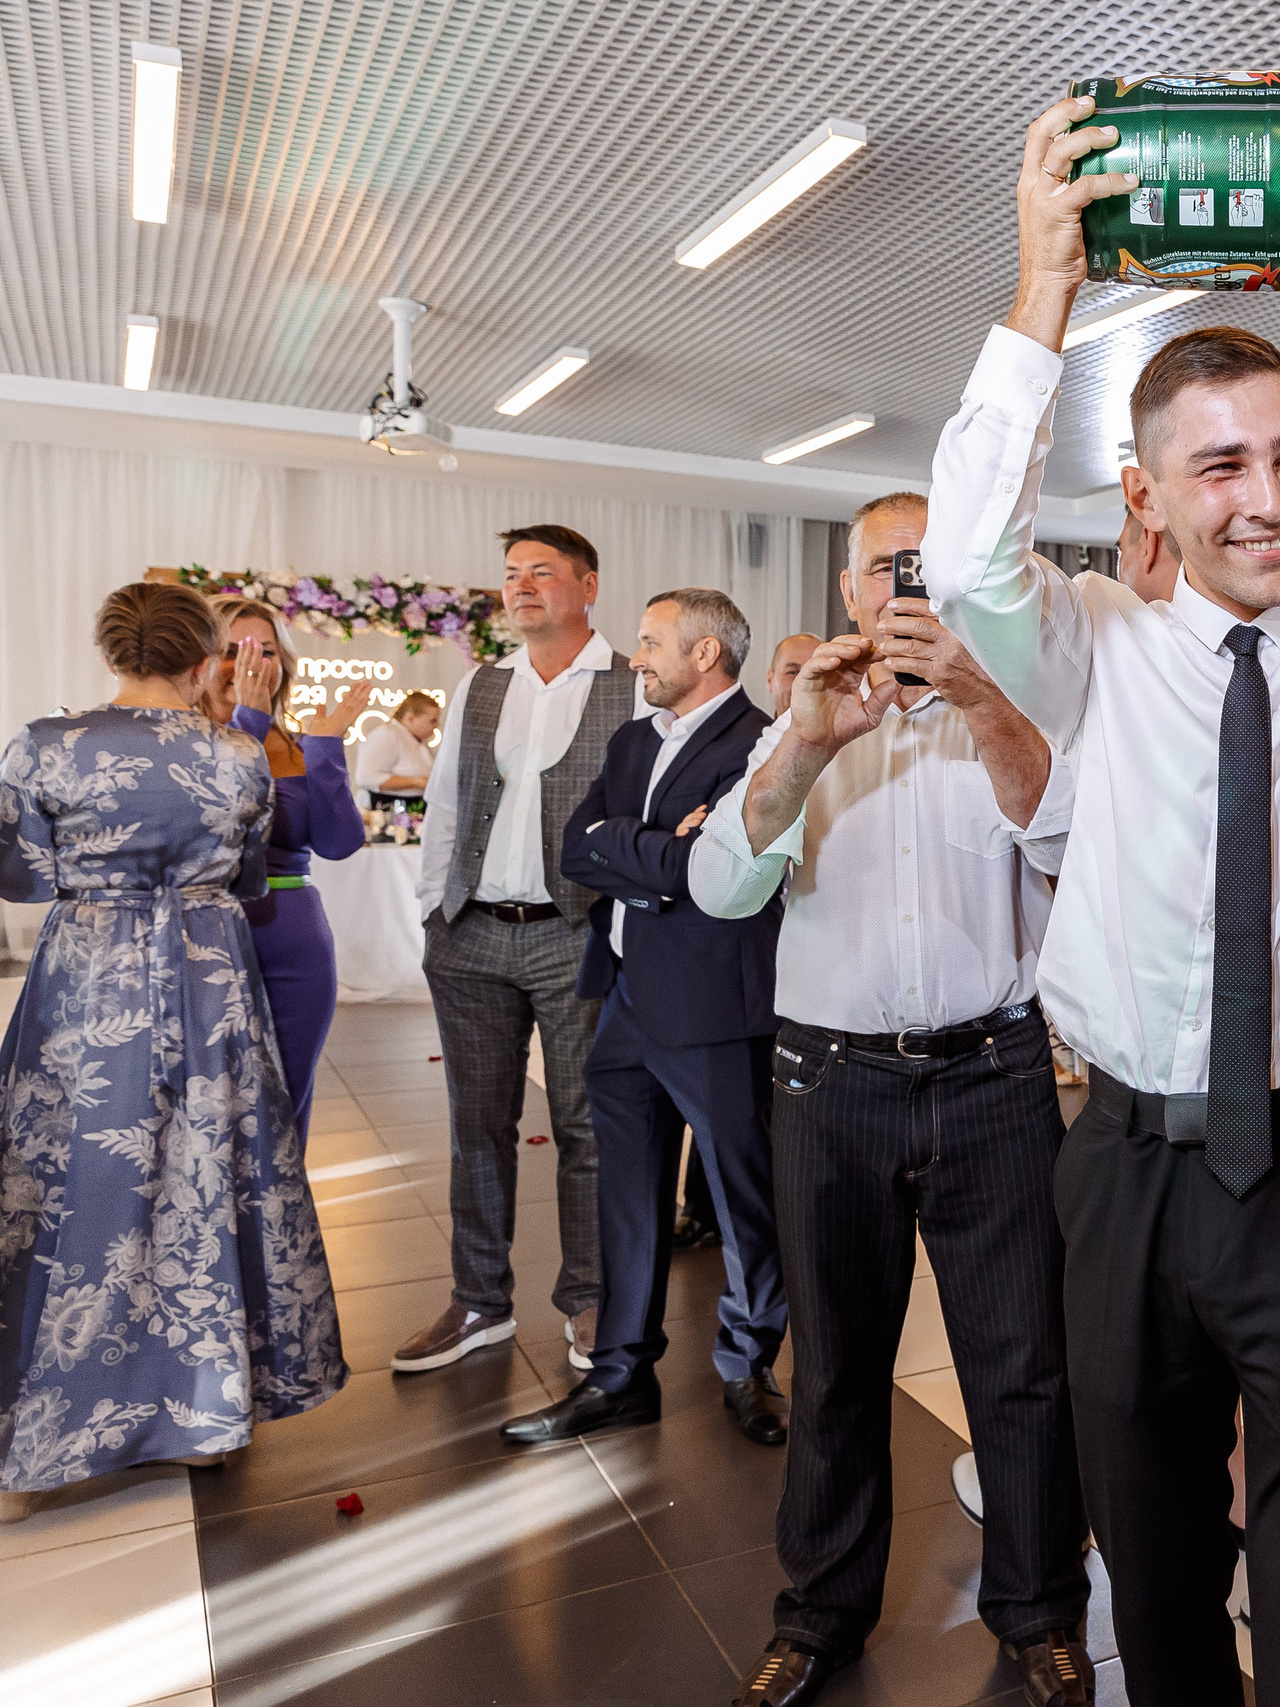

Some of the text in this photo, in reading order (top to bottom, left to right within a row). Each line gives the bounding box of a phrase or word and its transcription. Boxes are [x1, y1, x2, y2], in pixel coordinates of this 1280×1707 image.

[1162, 250, 1191, 260] Güteklasse
[1255, 250, 1267, 258] Echt
[297, 657, 394, 684] просто
